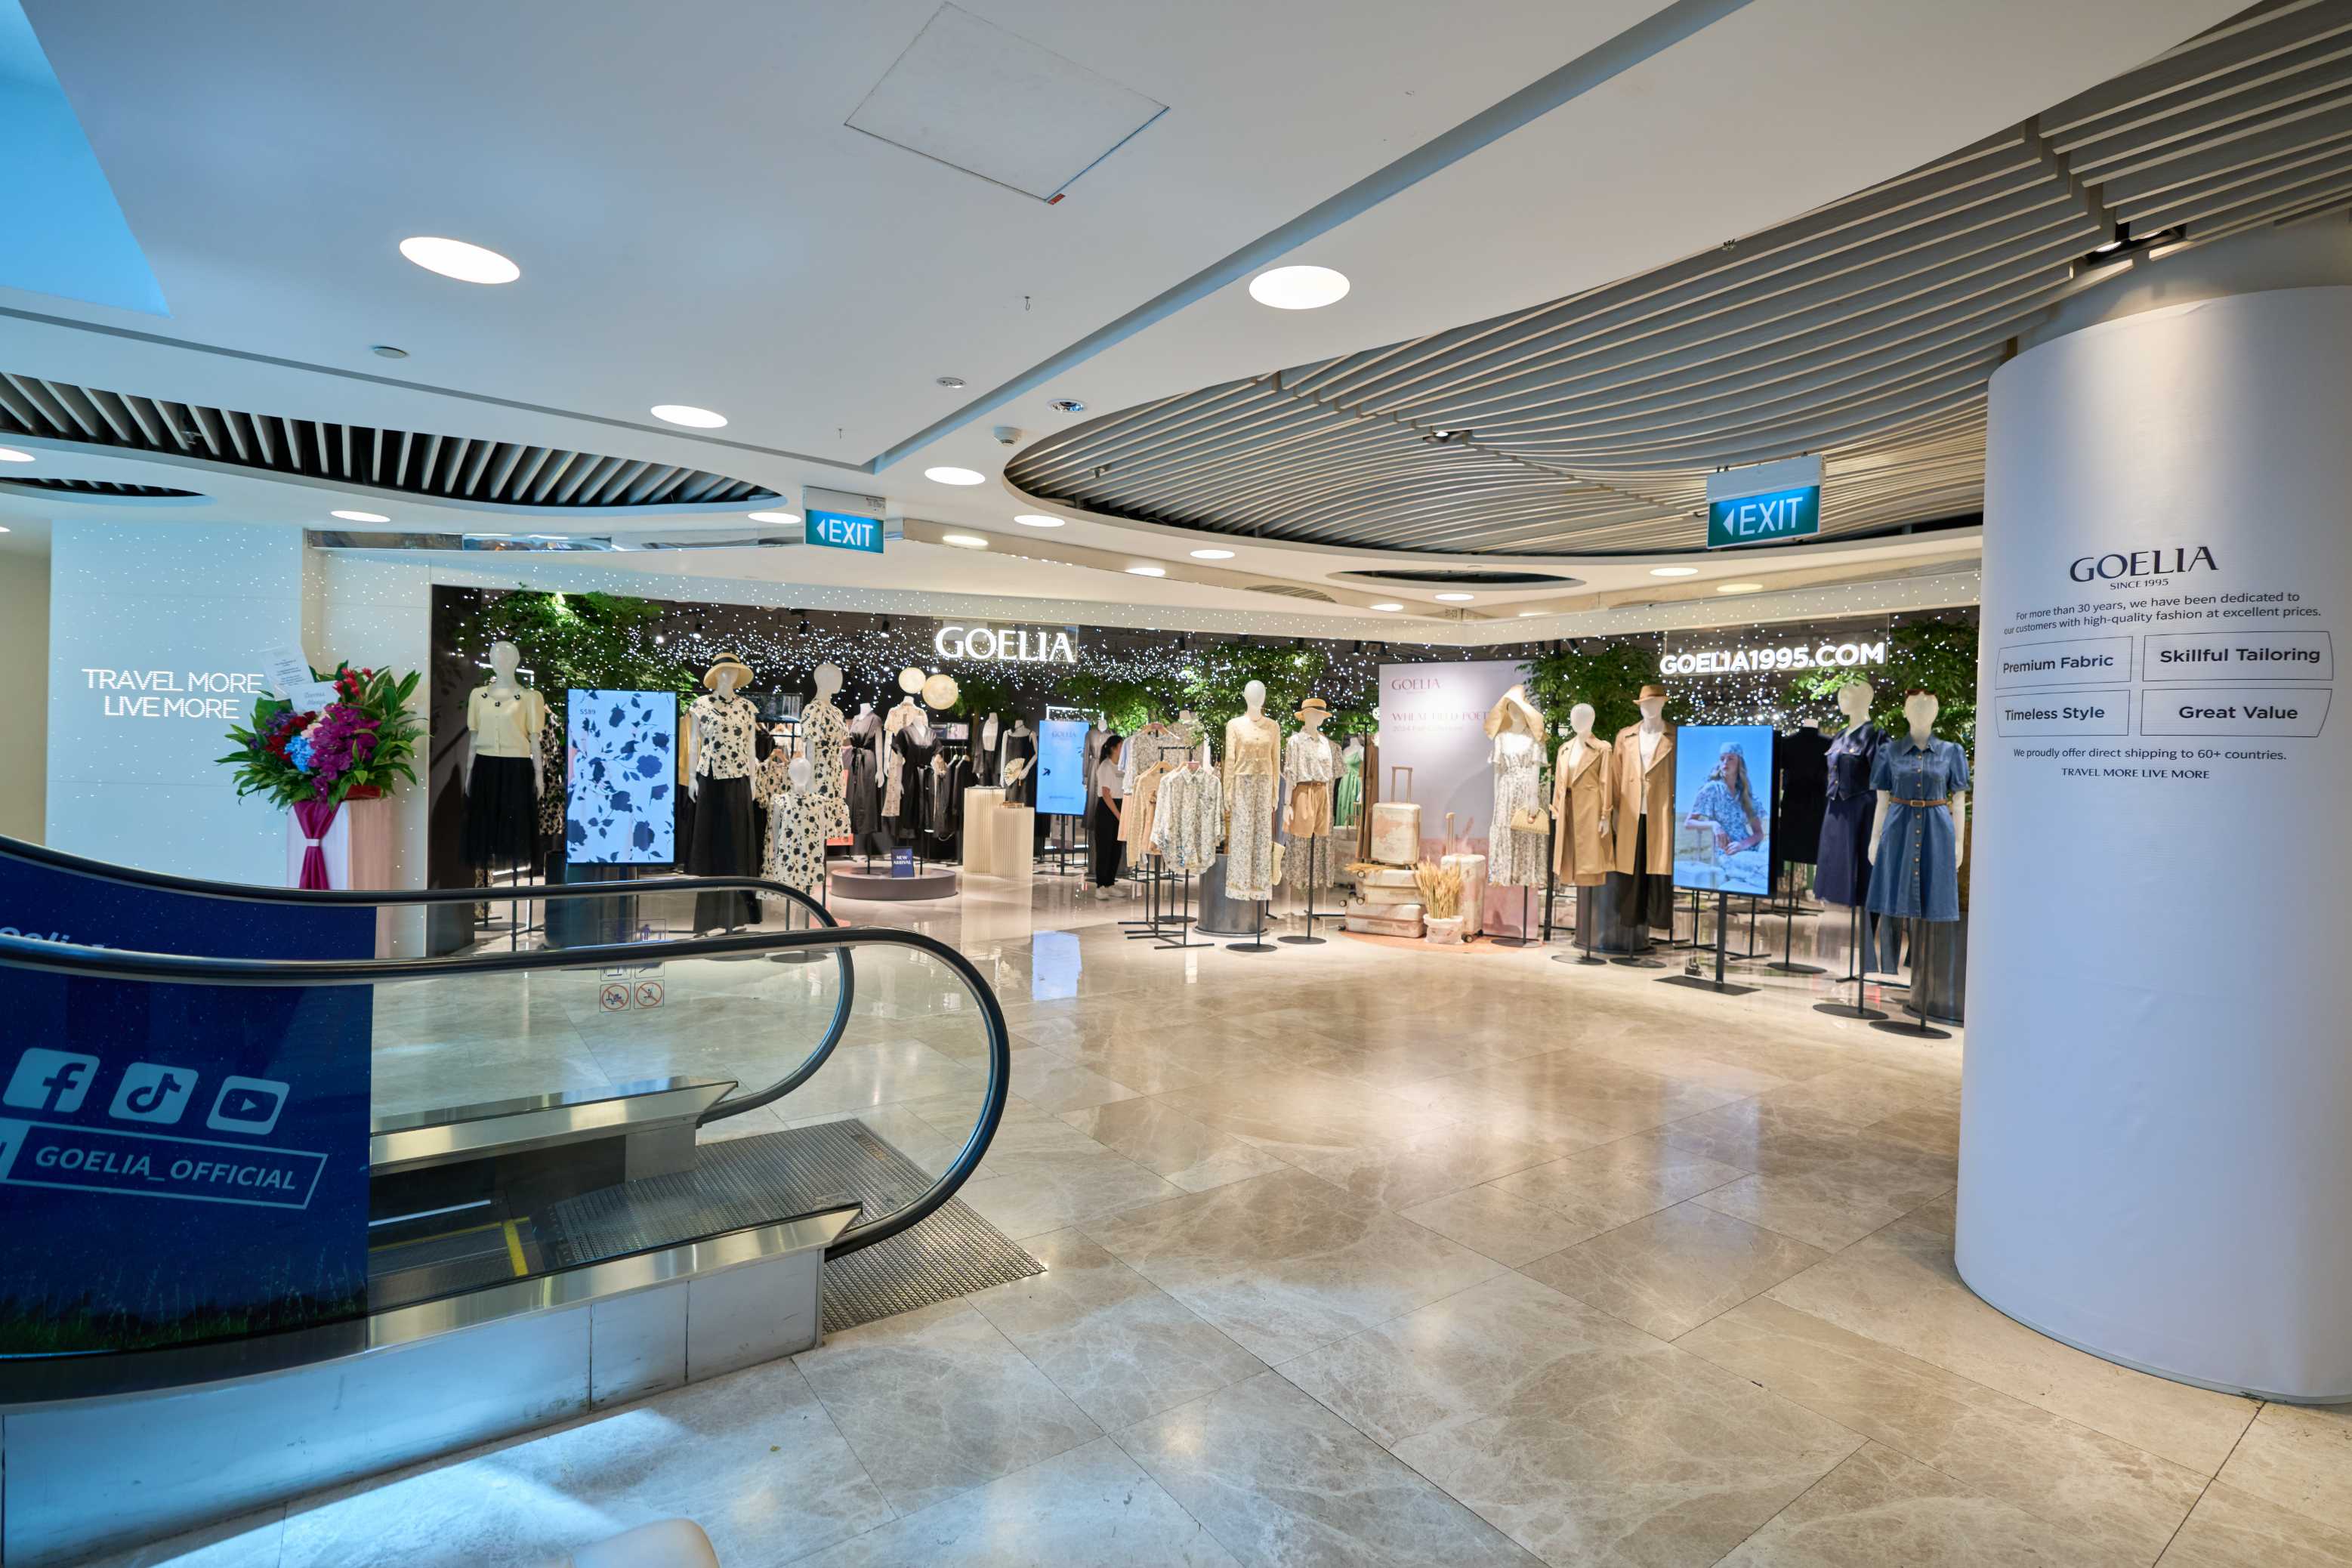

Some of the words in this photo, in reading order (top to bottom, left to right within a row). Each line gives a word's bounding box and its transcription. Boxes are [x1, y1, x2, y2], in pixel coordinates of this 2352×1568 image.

[1739, 496, 1803, 536] EXIT
[829, 519, 874, 547] EXIT
[2070, 546, 2219, 582] GOELIA
[2110, 581, 2141, 590] SINCE
[2144, 578, 2169, 587] 1995
[2016, 611, 2028, 621] For
[2029, 609, 2051, 619] more
[2053, 606, 2075, 616] than
[2078, 603, 2090, 613] 30
[2092, 601, 2126, 613] years,
[2130, 600, 2147, 608] we
[2151, 597, 2181, 607] have
[2184, 595, 2216, 605] been
[2221, 591, 2284, 603] dedicated
[2288, 593, 2301, 602] to
[2004, 627, 2016, 635] our
[2016, 622, 2057, 634] customers
[2055, 616, 2080, 628] with
[2084, 612, 2153, 628] high-quality
[2156, 610, 2202, 621] fashion
[2206, 608, 2219, 618] at
[2223, 607, 2279, 618] excellent
[2283, 606, 2321, 619] prices.
[935, 625, 1076, 663] GOELIA
[2159, 648, 2229, 663] Skillful
[2236, 648, 2321, 664] Tailoring
[1659, 642, 1886, 675] GOELIA1995.COM
[2003, 659, 2055, 674] Premium
[2060, 655, 2114, 669] Fabric
[81, 668, 184, 692] TRAVEL
[188, 671, 264, 693] MORE
[1391, 678, 1440, 690] GOELIA
[104, 696, 161, 717] LIVE
[163, 698, 240, 719] MORE
[2005, 708, 2058, 721] Timeless
[2062, 706, 2105, 721] Style
[2178, 706, 2236, 719] Great
[2243, 705, 2298, 719] Value
[2014, 748, 2025, 757] We
[2026, 748, 2060, 759] proudly
[2062, 748, 2085, 757] offer
[2088, 748, 2122, 758] direct
[2125, 749, 2177, 761] shipping
[2181, 749, 2193, 758] to
[2197, 749, 2221, 759] 60+
[2224, 750, 2287, 760] countries.
[2061, 767, 2100, 776] TRAVEL
[2103, 768, 2139, 777] MORE
[2142, 769, 2168, 778] LIVE
[2171, 770, 2210, 779] MORE
[35, 1145, 296, 1190] GOELIA_OFFICIAL
